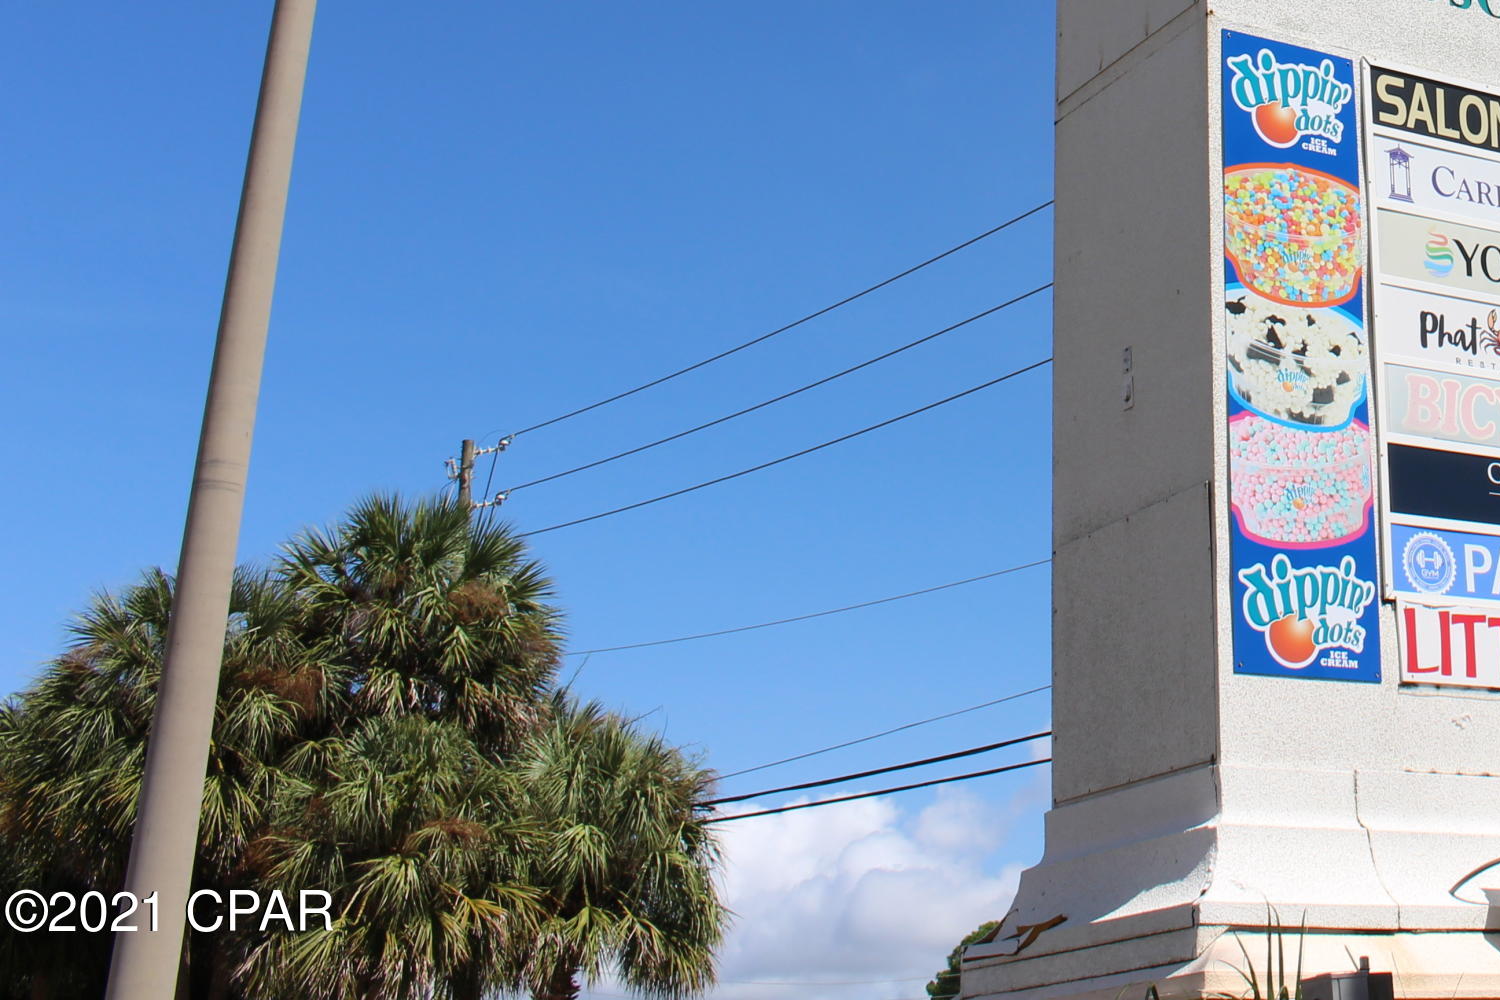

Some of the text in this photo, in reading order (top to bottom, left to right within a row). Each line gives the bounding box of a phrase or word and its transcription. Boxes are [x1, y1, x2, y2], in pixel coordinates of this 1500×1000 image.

[1295, 108, 1341, 140] dots
[1310, 136, 1328, 146] ICE
[1302, 142, 1337, 156] CREAM
[1419, 310, 1482, 356] Phat
[1312, 617, 1363, 648] dots
[1329, 650, 1348, 660] ICE
[1320, 658, 1359, 669] CREAM
